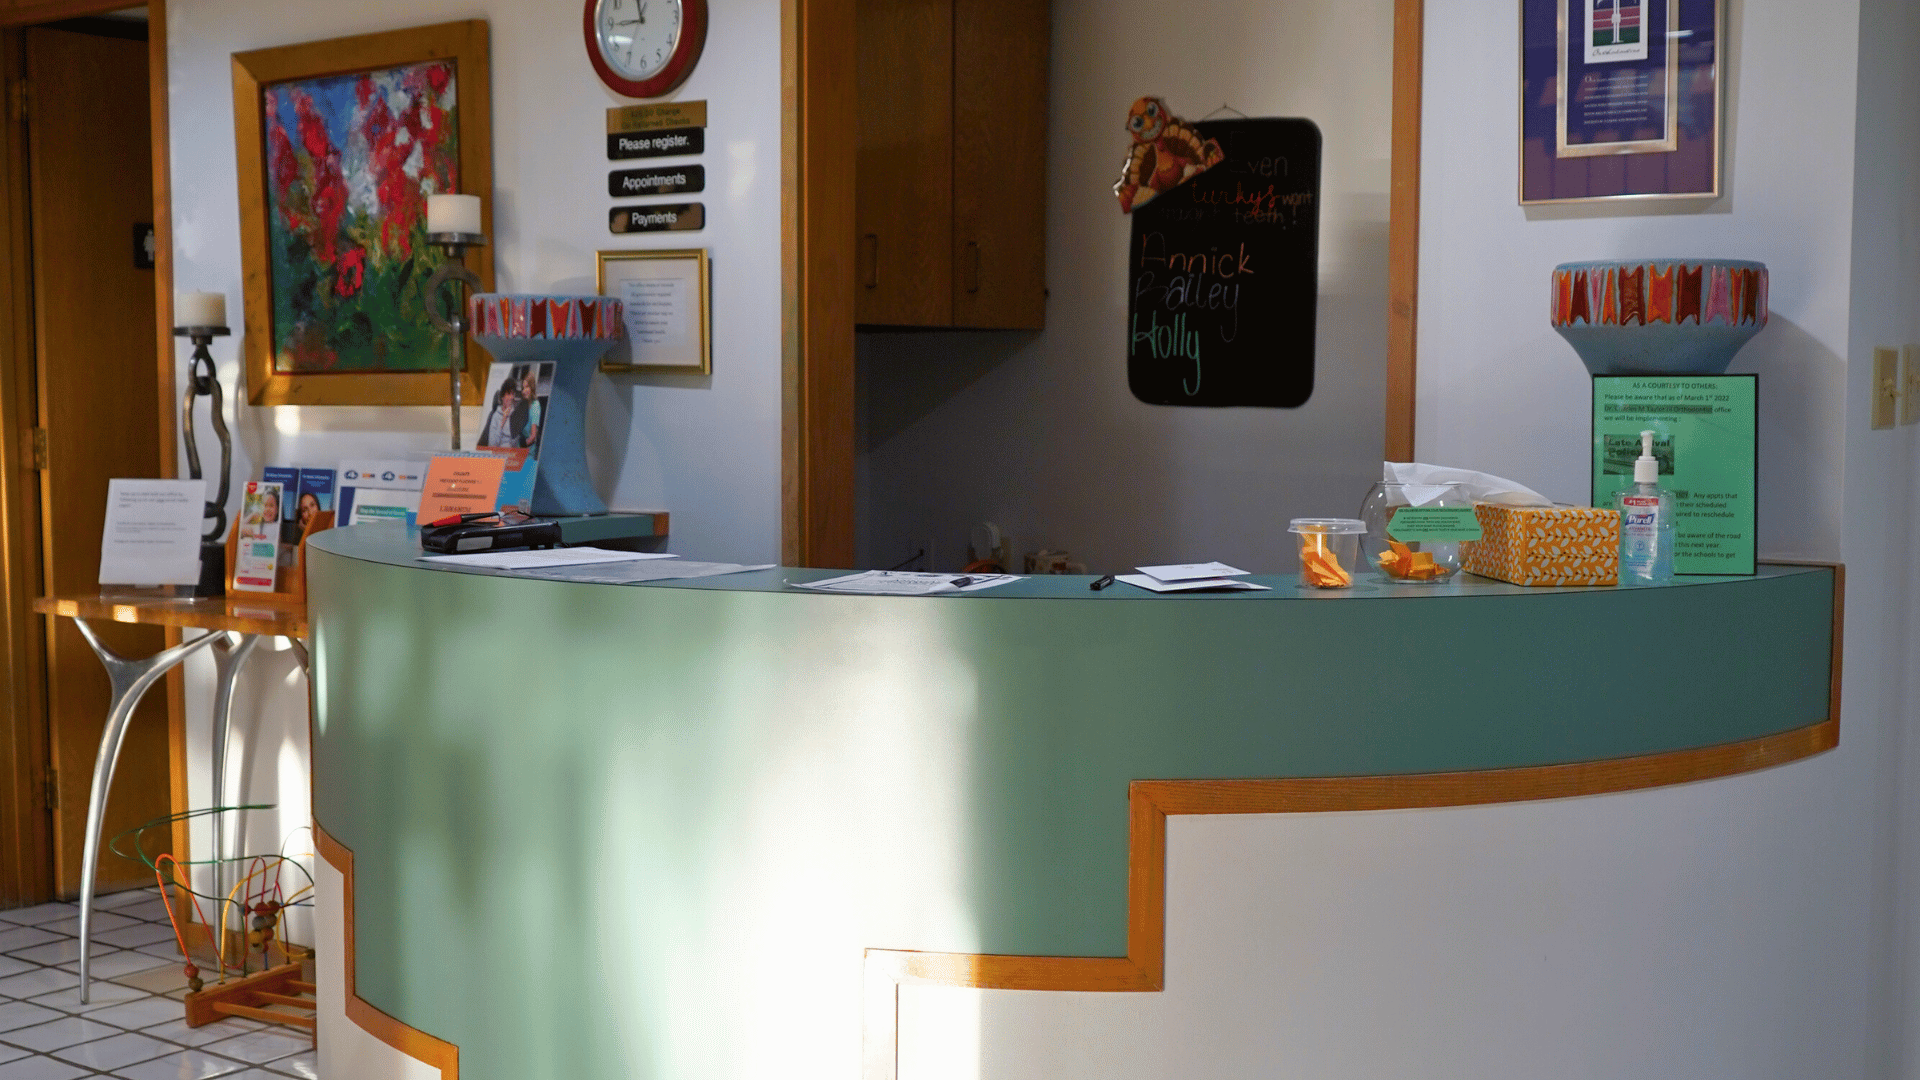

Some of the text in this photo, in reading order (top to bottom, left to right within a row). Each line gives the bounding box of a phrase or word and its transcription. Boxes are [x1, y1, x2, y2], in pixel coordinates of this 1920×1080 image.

[608, 16, 614, 30] 9
[666, 33, 672, 48] 4
[640, 54, 648, 69] 6
[655, 48, 662, 64] 5
[619, 134, 690, 150] Please register.
[1230, 130, 1288, 177] Even
[622, 173, 686, 190] Appointments
[632, 212, 678, 228] Payments
[1140, 231, 1255, 279] Annick
[1134, 270, 1240, 343] Bailey
[1132, 310, 1201, 396] Holly
[1634, 439, 1670, 447] Aival
[1628, 515, 1652, 524] Purell
